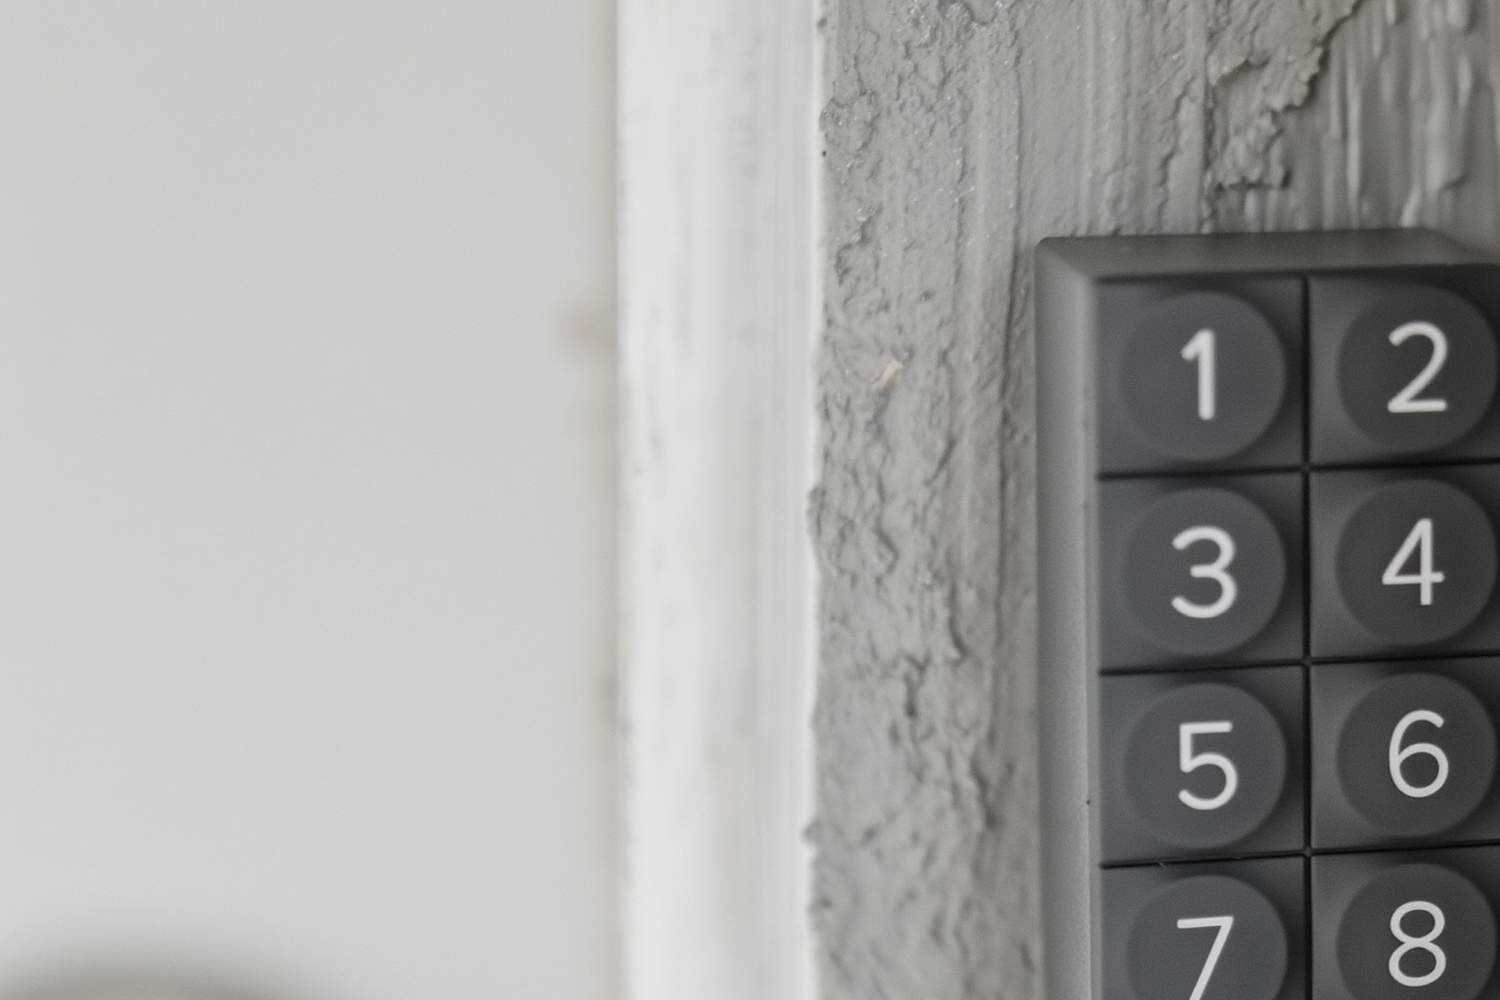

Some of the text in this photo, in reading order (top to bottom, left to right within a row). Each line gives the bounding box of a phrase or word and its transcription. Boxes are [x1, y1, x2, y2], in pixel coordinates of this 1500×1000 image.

[1181, 329, 1215, 420] 1
[1388, 322, 1447, 413] 2
[1171, 526, 1237, 619] 3
[1382, 518, 1444, 605] 4
[1178, 721, 1238, 810] 5
[1389, 710, 1449, 798] 6
[1388, 900, 1446, 987] 8
